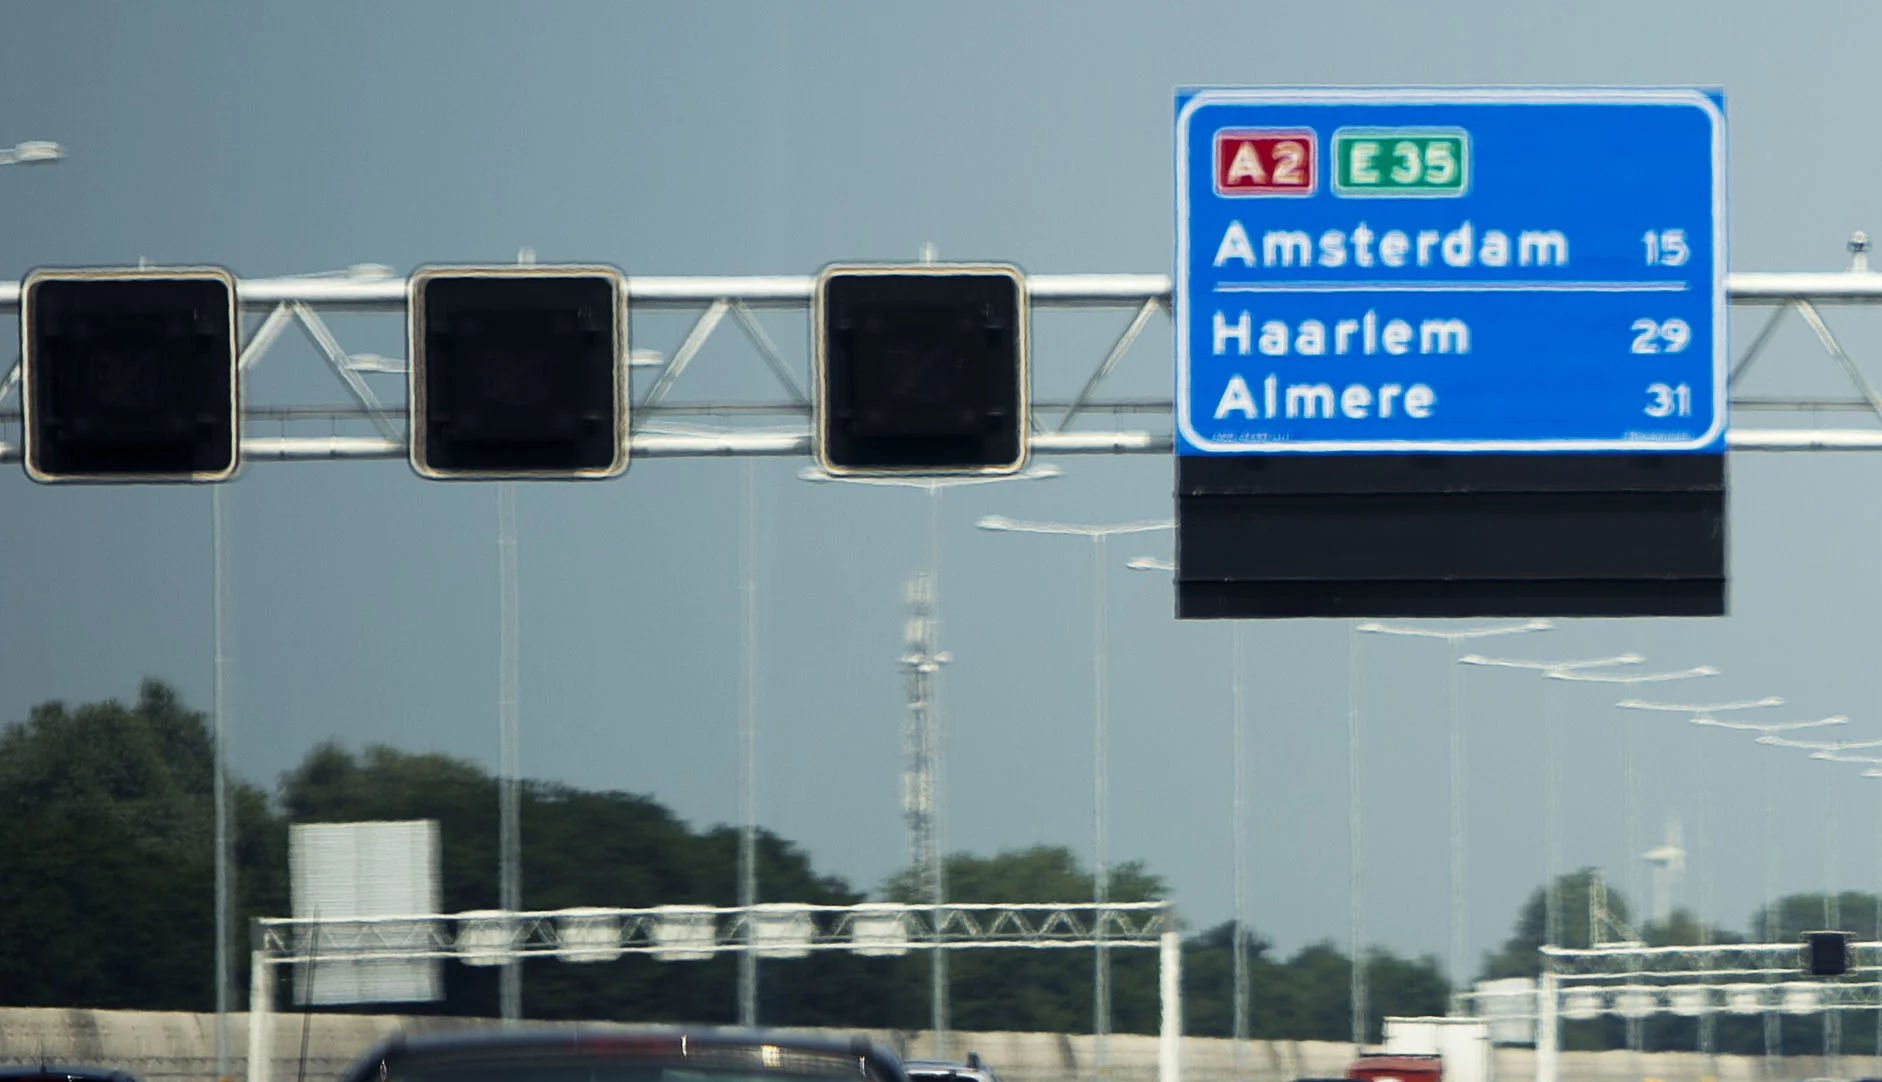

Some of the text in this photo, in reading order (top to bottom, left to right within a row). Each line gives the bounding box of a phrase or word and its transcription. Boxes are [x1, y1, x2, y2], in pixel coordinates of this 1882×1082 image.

[1213, 220, 1690, 267] Amsterdam 15
[1212, 310, 1690, 355] Haarlem 29
[1213, 374, 1691, 419] Almere 31
